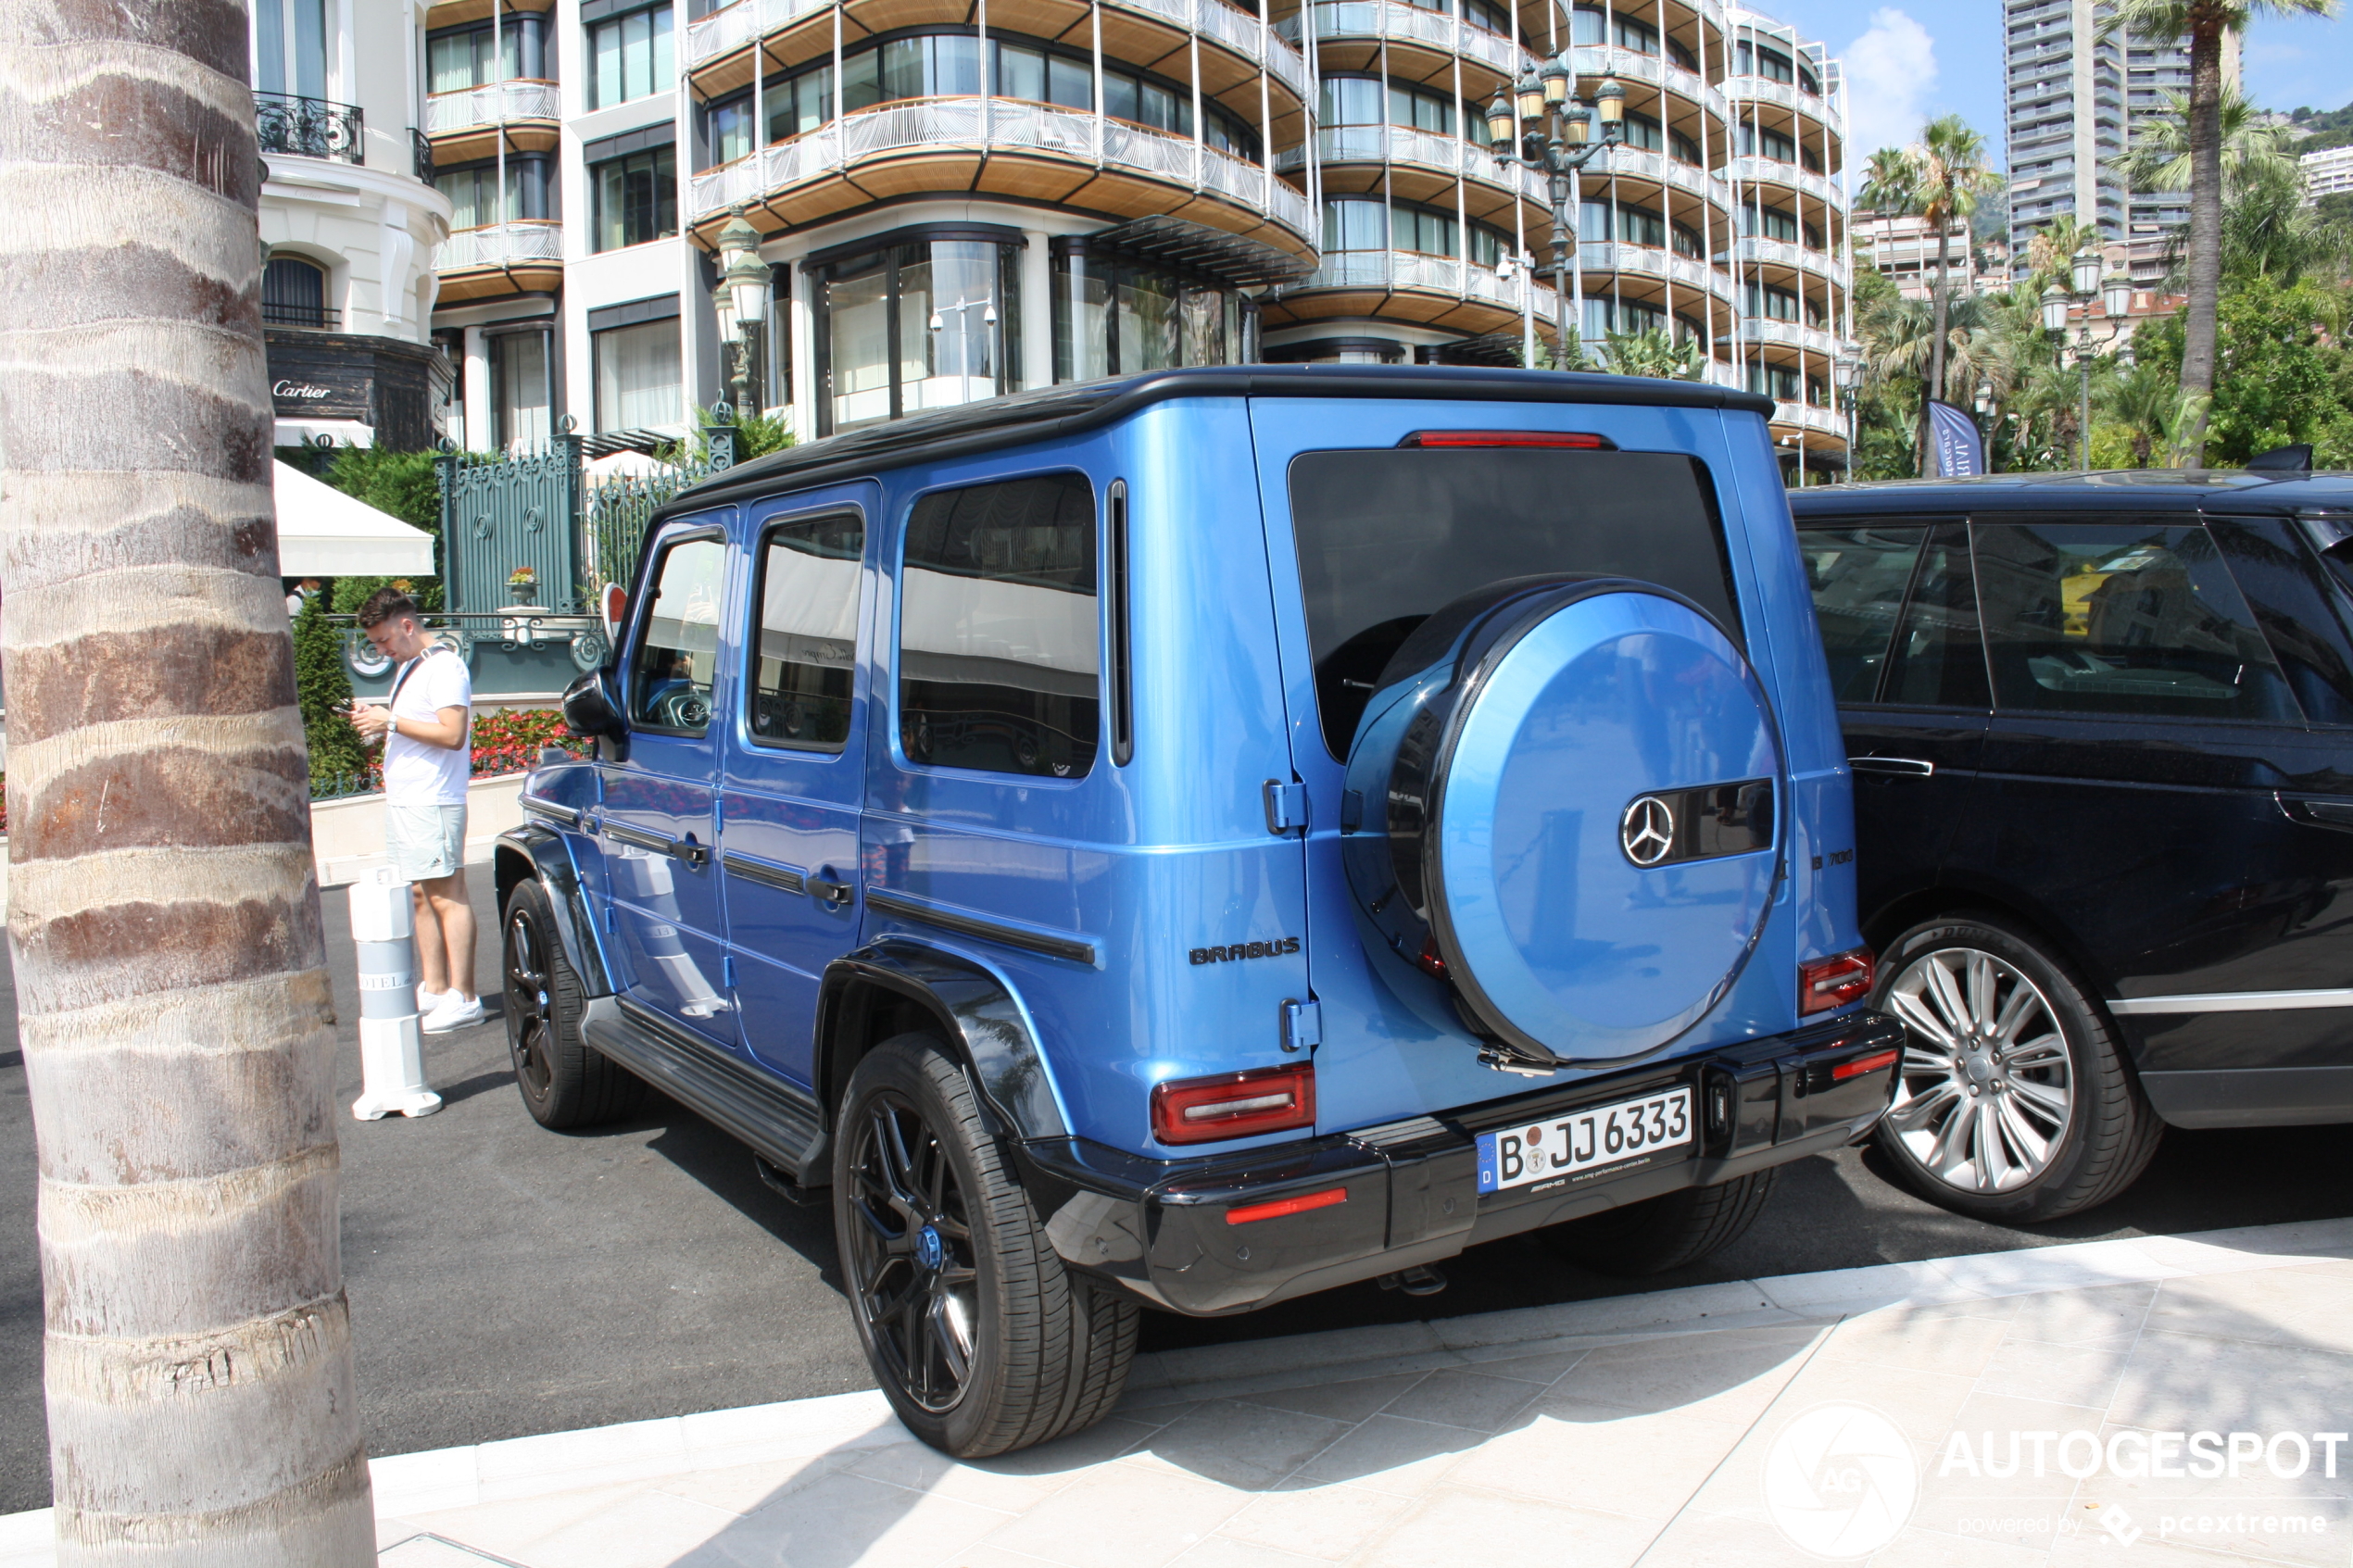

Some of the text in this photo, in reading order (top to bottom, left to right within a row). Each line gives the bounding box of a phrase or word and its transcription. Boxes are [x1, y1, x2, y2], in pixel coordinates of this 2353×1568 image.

[272, 380, 331, 398] Cartier
[1812, 848, 1854, 871] B 700
[1189, 936, 1301, 965] BRABUS
[1501, 1135, 1524, 1182] B
[1604, 1094, 1687, 1155] 6333
[1482, 1170, 1491, 1184] D
[1538, 1179, 1566, 1191] AMG
